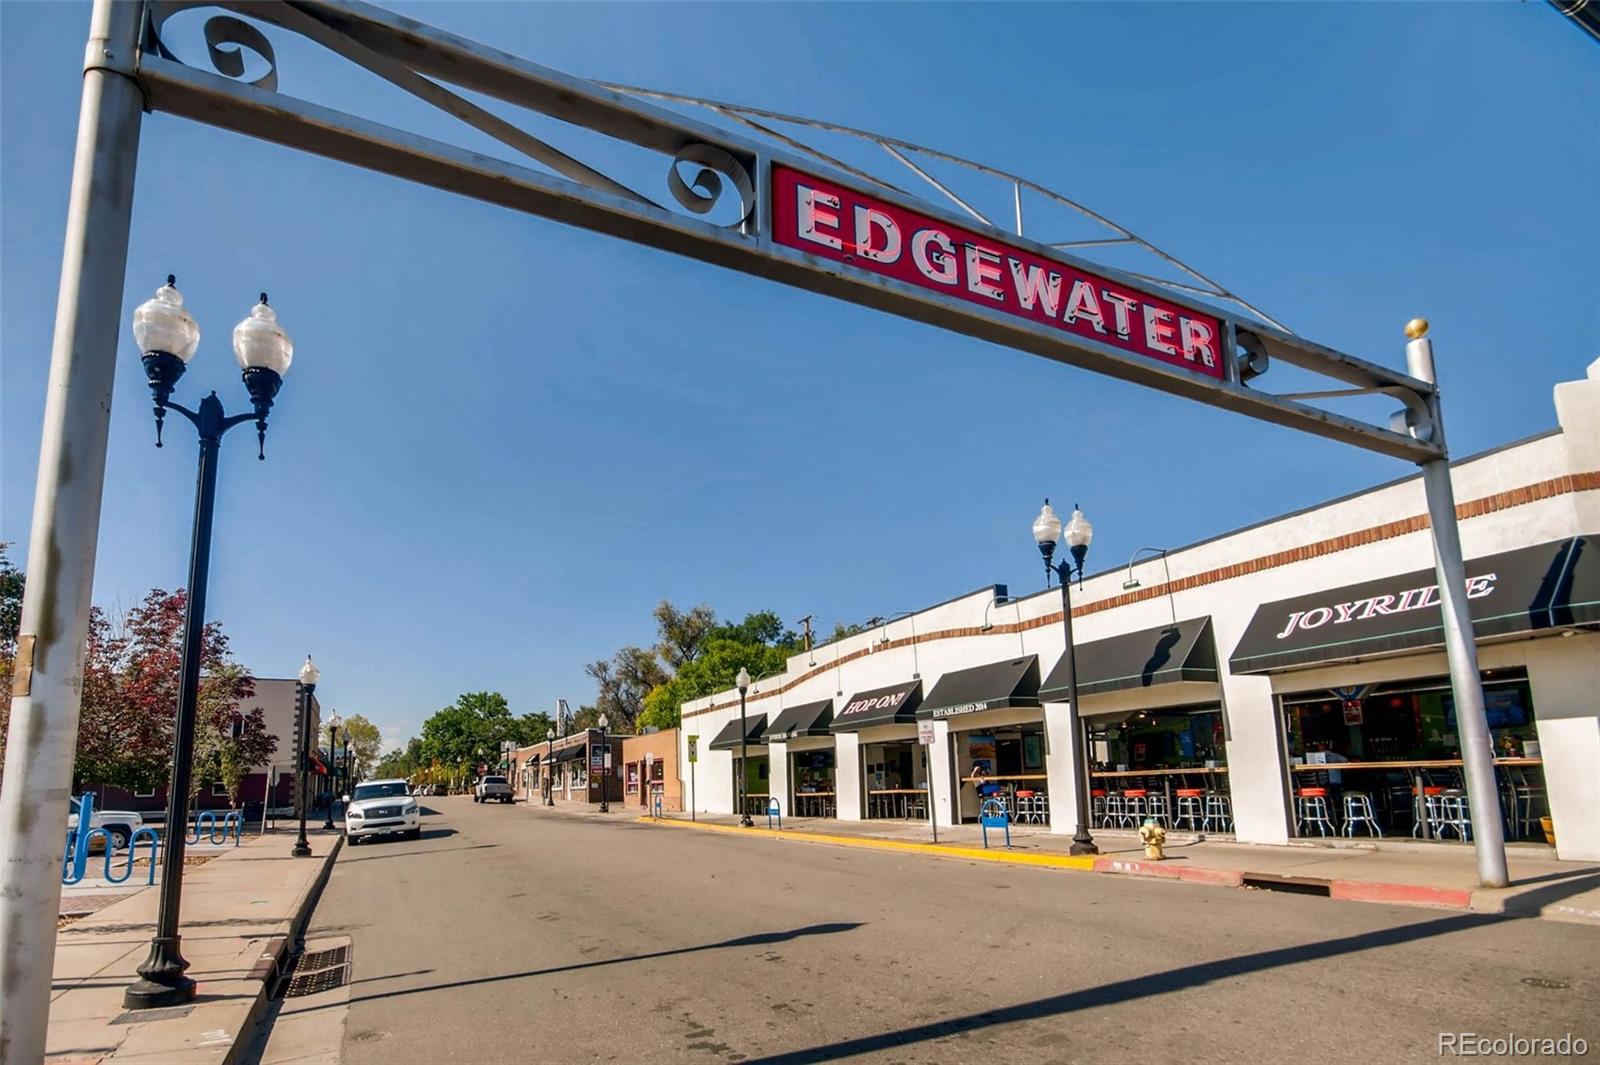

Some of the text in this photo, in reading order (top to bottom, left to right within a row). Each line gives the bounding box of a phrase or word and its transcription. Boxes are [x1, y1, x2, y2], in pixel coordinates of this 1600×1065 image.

[796, 184, 1216, 367] EDGEWATER
[843, 698, 877, 715] HOP
[933, 704, 974, 718] ESTABLISHED
